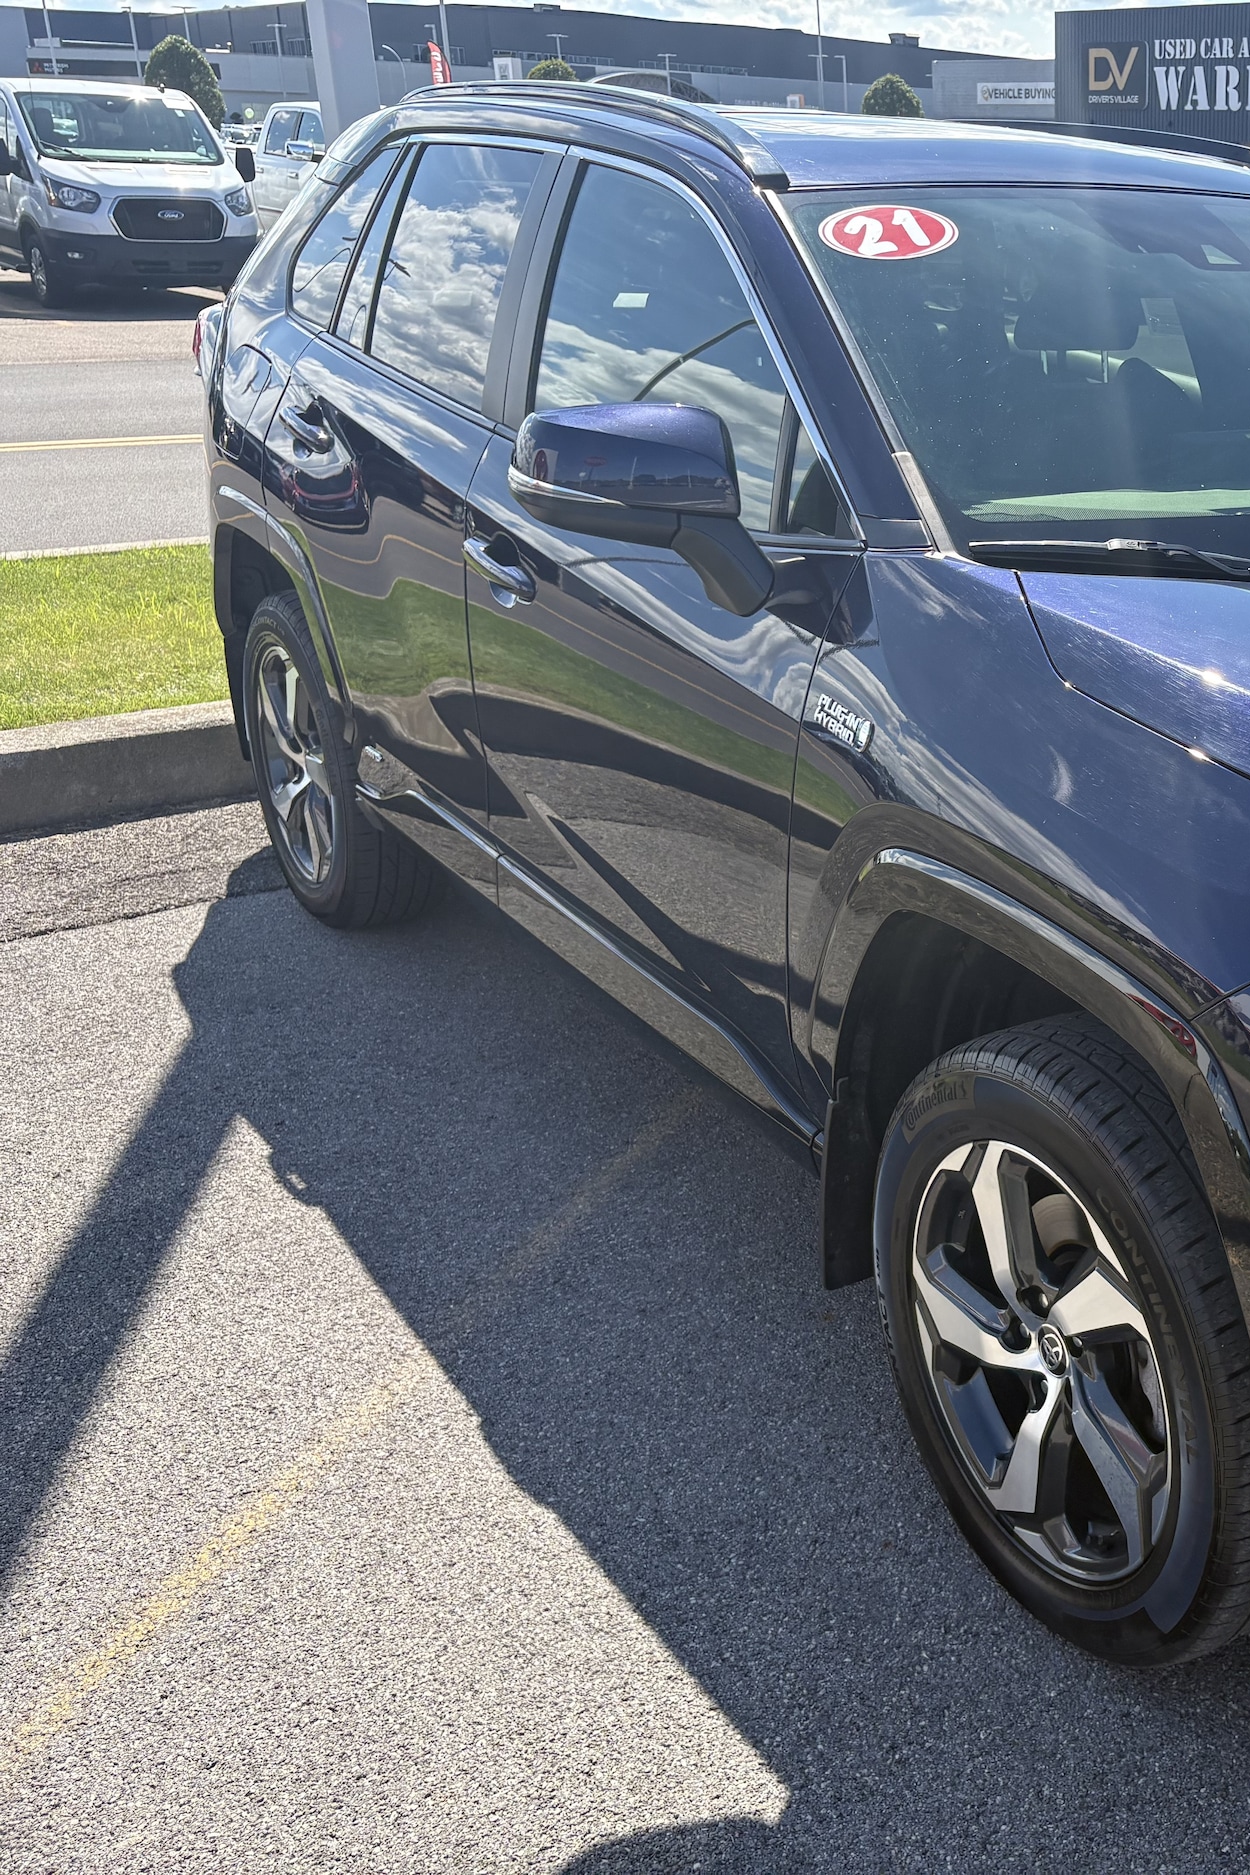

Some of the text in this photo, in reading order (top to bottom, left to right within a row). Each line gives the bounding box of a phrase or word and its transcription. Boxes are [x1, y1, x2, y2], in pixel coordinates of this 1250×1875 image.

[1088, 47, 1139, 91] DV
[1154, 39, 1196, 60] USED
[1200, 37, 1235, 59] CAR
[988, 88, 1023, 99] VEHICLE
[1088, 95, 1139, 103] DRIVER'S VILLAGE
[843, 208, 931, 256] 21
[813, 706, 855, 747] HYBRID
[817, 693, 866, 731] PLUG-IN
[905, 1080, 958, 1131] Continental
[1096, 1188, 1198, 1465] CONTINENTAL
